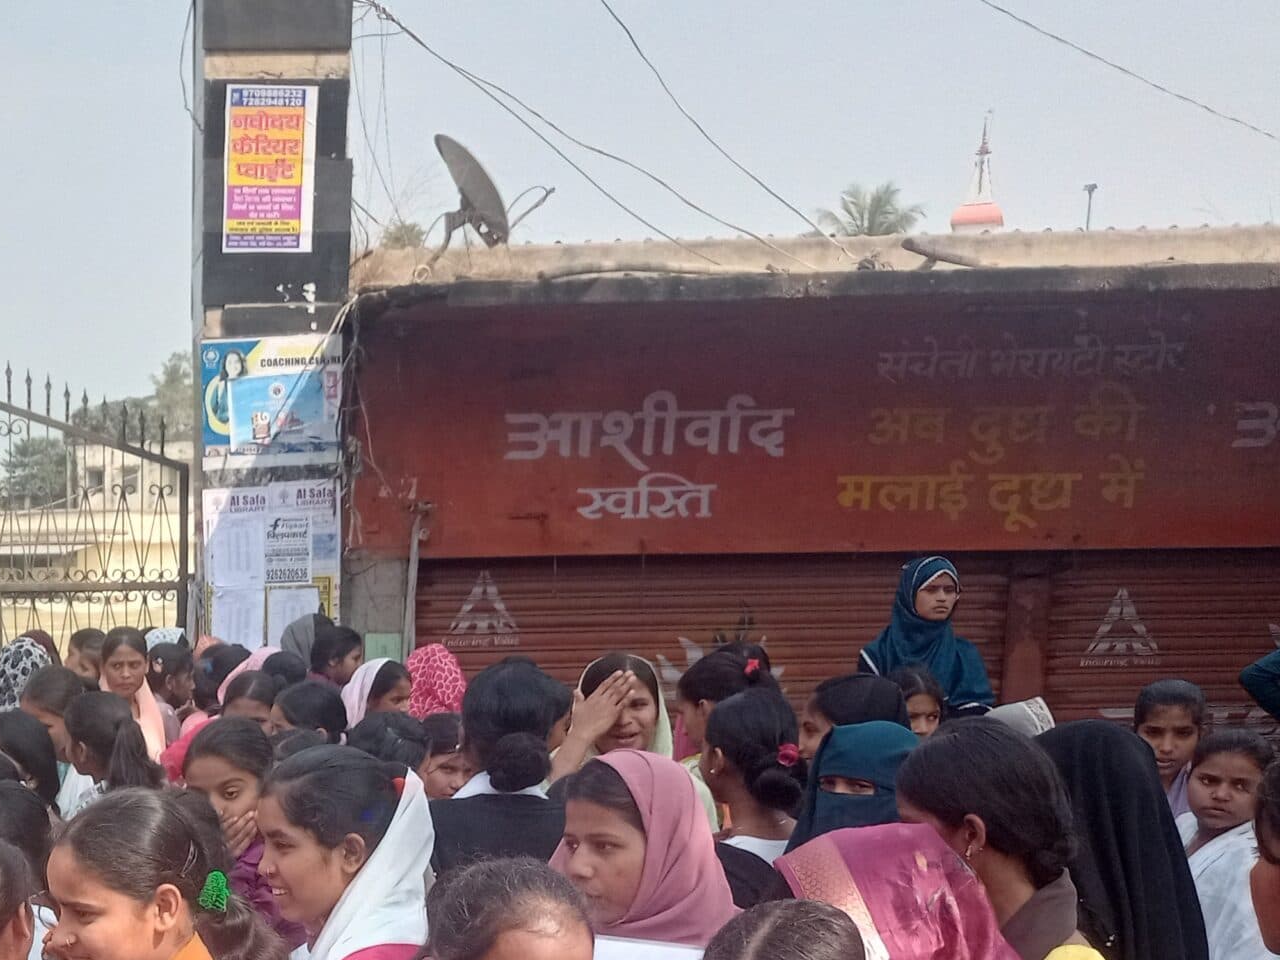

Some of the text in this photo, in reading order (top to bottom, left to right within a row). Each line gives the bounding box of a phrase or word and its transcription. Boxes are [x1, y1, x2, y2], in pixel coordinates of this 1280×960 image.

[260, 356, 306, 368] COACHING
[504, 390, 795, 472] आशीर्वाद
[867, 405, 951, 446] अब
[1073, 379, 1148, 442] की
[231, 494, 266, 507] Al Safa
[296, 487, 335, 499] Al Safa
[576, 472, 718, 519] स्वस्ति
[836, 459, 974, 521] मलाई
[1099, 453, 1146, 508] में
